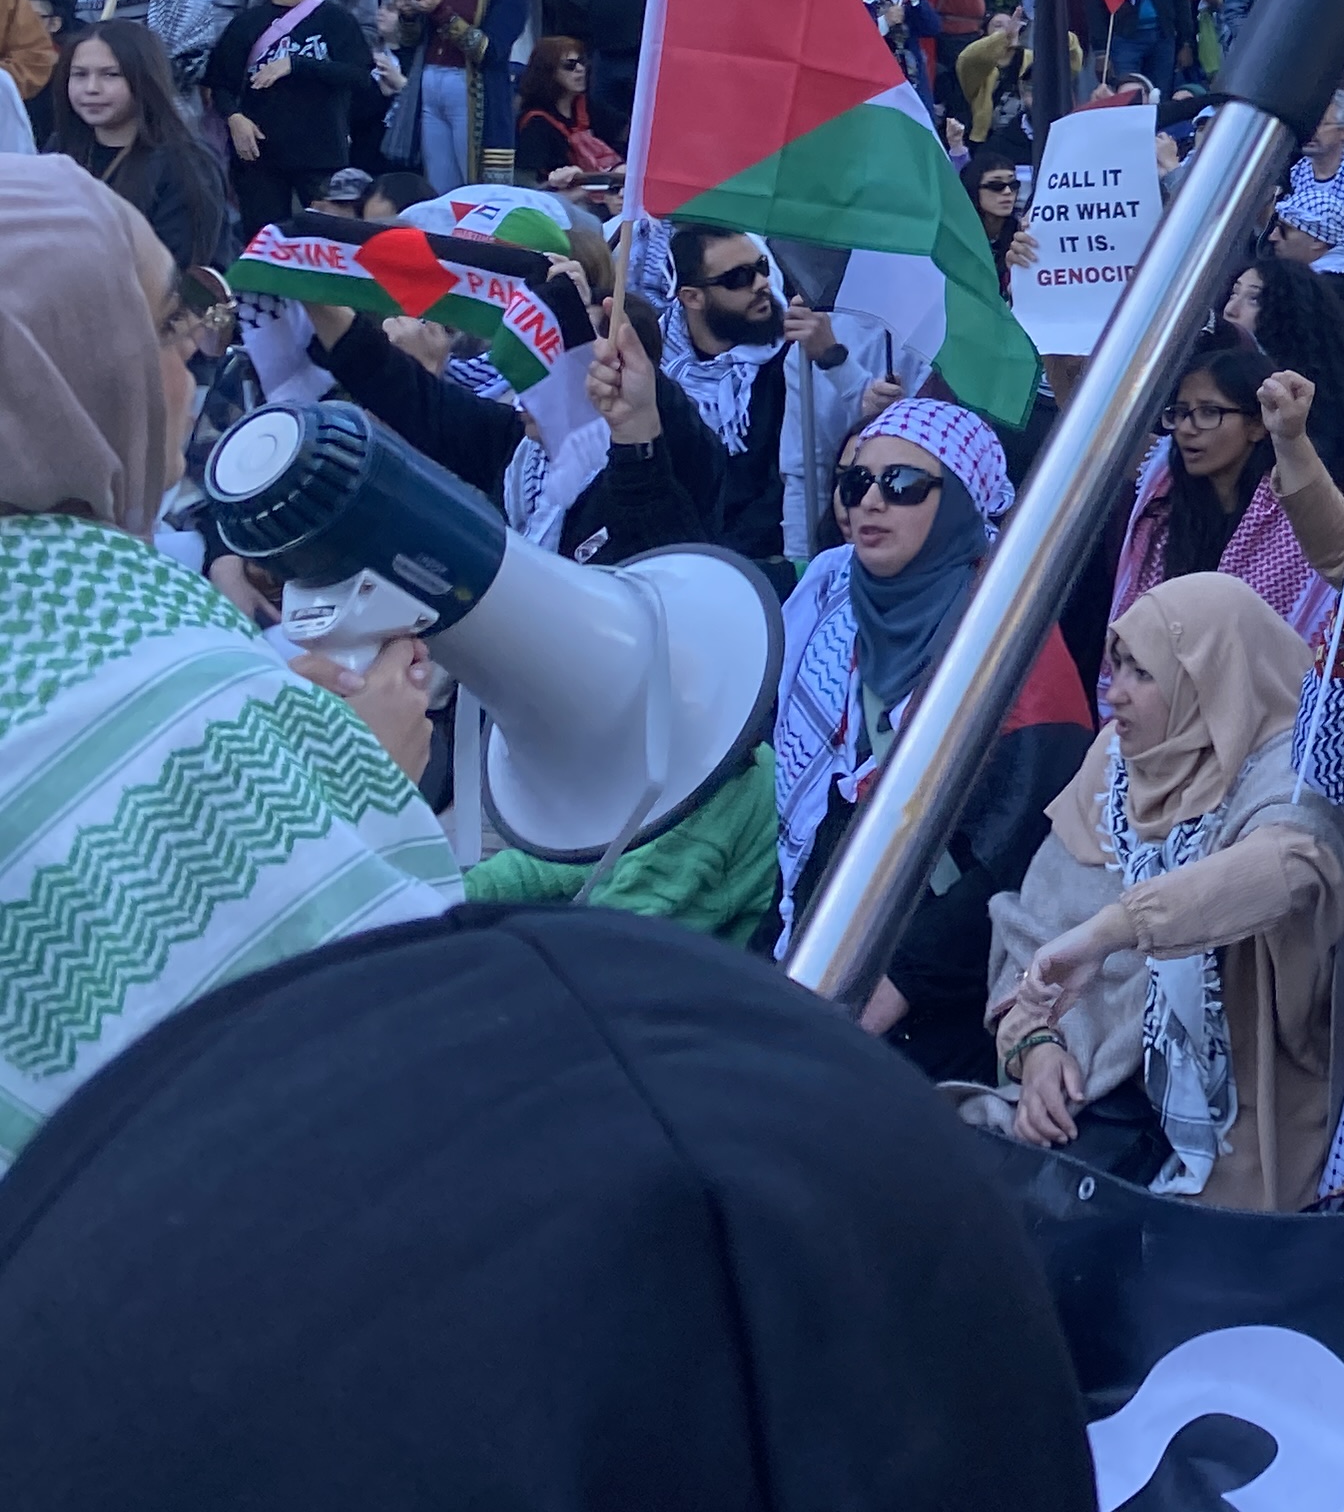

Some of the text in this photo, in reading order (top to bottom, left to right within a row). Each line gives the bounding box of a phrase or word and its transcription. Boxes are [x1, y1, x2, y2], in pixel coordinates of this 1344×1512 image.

[1048, 169, 1122, 190] CALL IT
[1030, 200, 1140, 223] FOR WHAT
[1059, 235, 1116, 253] IT IS.
